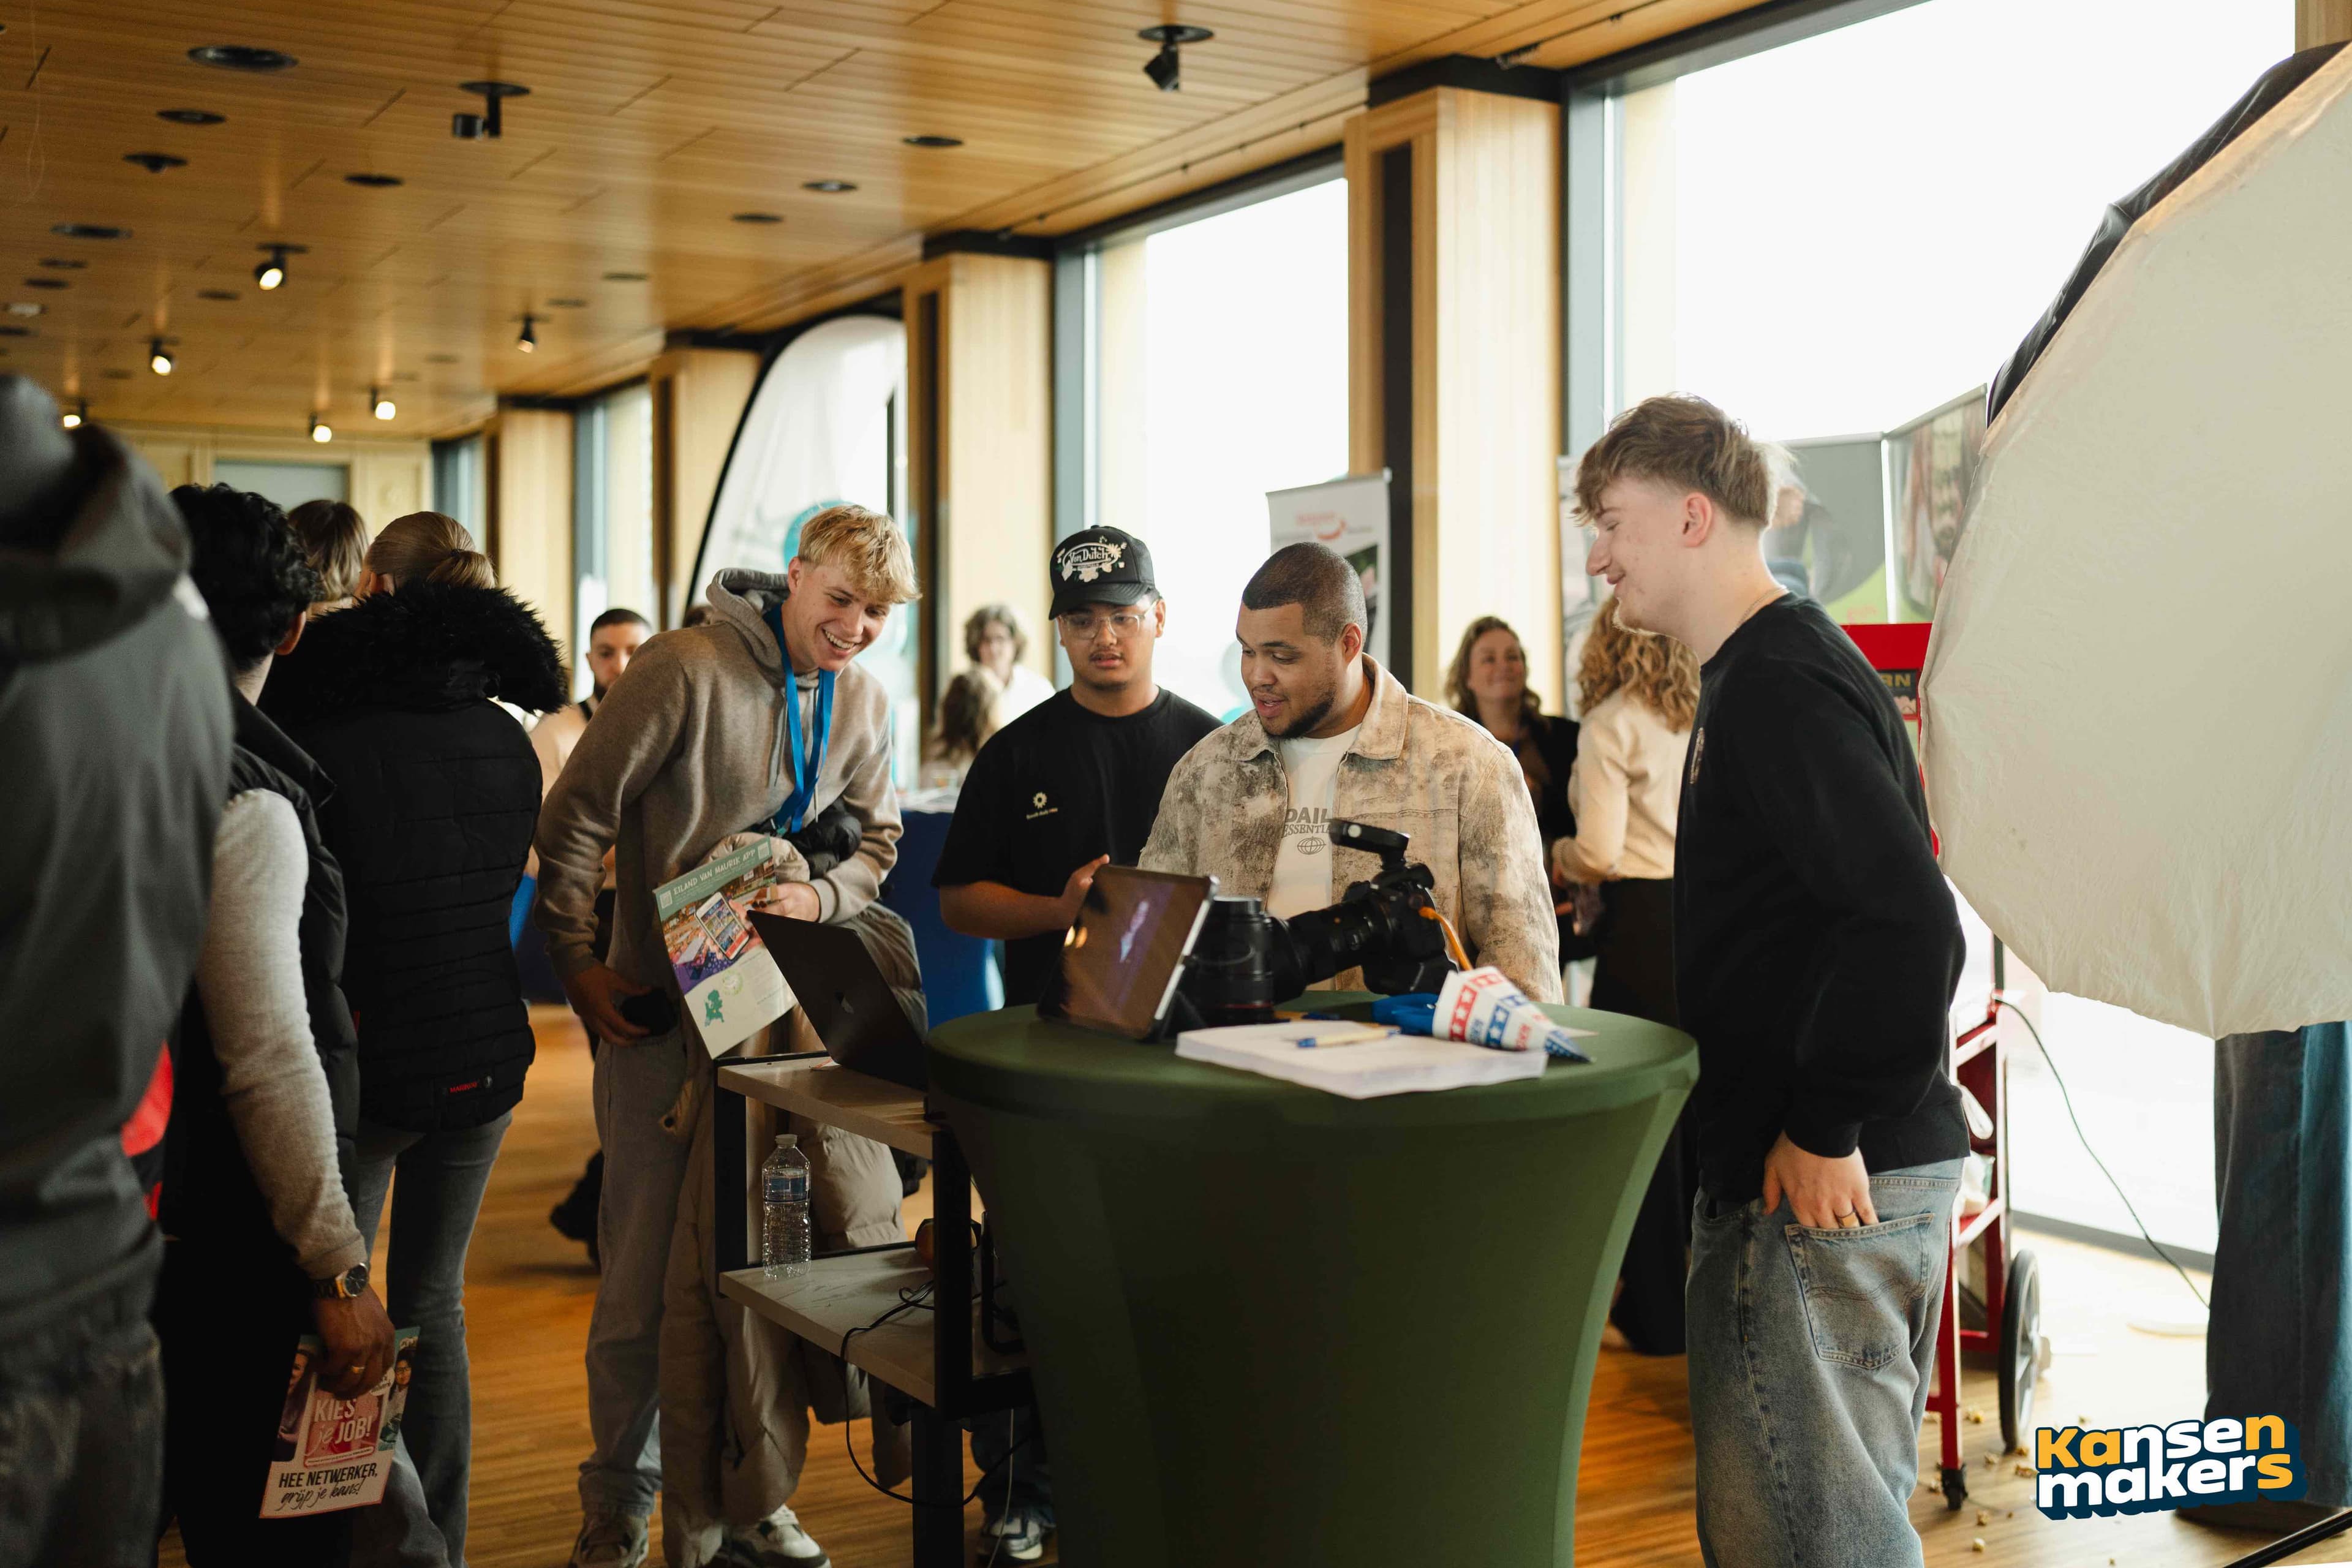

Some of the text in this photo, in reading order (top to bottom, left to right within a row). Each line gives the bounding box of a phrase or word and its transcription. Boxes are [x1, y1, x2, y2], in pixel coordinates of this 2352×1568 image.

[1069, 547, 1109, 563] Von Dutch
[1284, 807, 1330, 824] DAIL
[674, 877, 698, 895] EILAND
[699, 870, 712, 881] VAN
[715, 857, 741, 873] MAURIK
[743, 849, 755, 862] APP
[314, 1399, 356, 1422] KIES
[335, 1416, 372, 1444] JOB!
[279, 1472, 305, 1488] HEE
[307, 1487, 327, 1508] je
[330, 1476, 366, 1498] kans!
